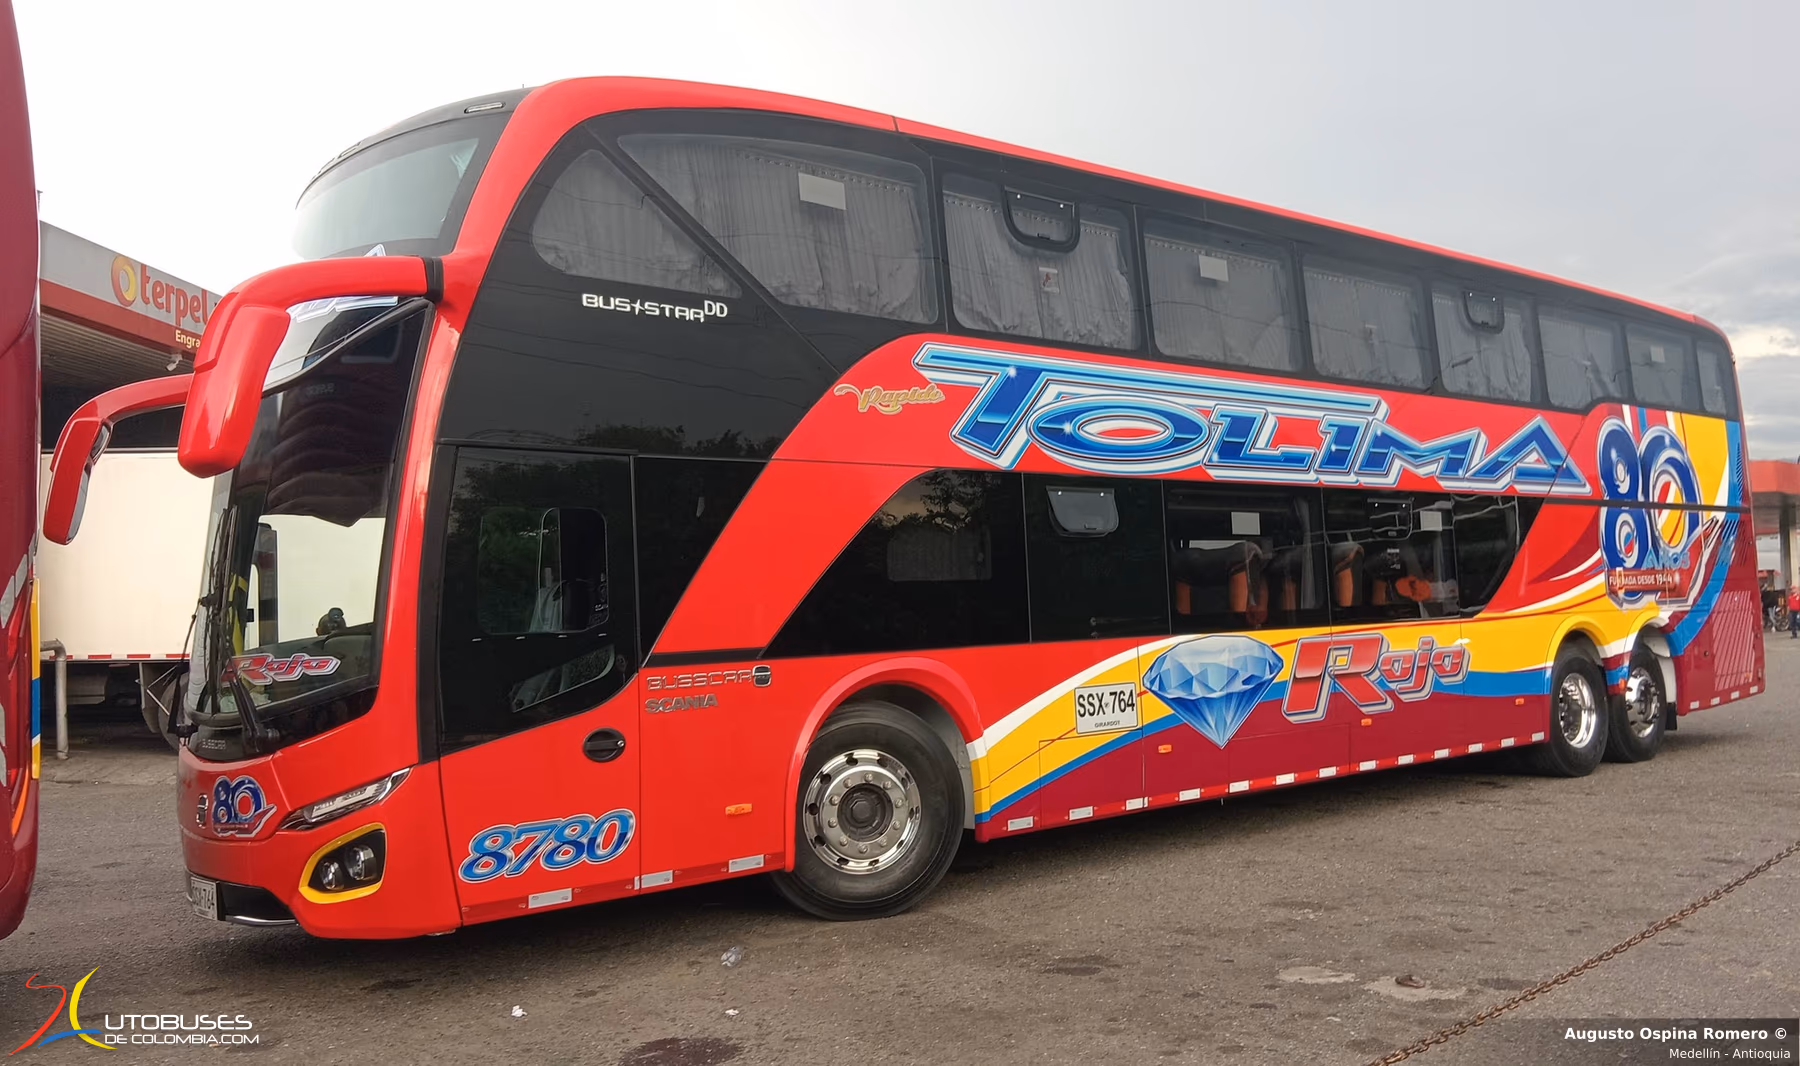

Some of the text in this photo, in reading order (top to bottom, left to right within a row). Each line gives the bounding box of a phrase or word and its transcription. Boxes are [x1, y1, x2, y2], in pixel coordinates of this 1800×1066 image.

[912, 341, 1592, 496] TOLIMA
[1597, 415, 1703, 600] 80
[221, 652, 341, 687] Rojo
[646, 669, 753, 691] BUSSCAR
[1282, 632, 1470, 724] Rojo
[645, 692, 718, 714] SCANIA
[212, 774, 267, 829] 80
[458, 808, 637, 884] 8780
